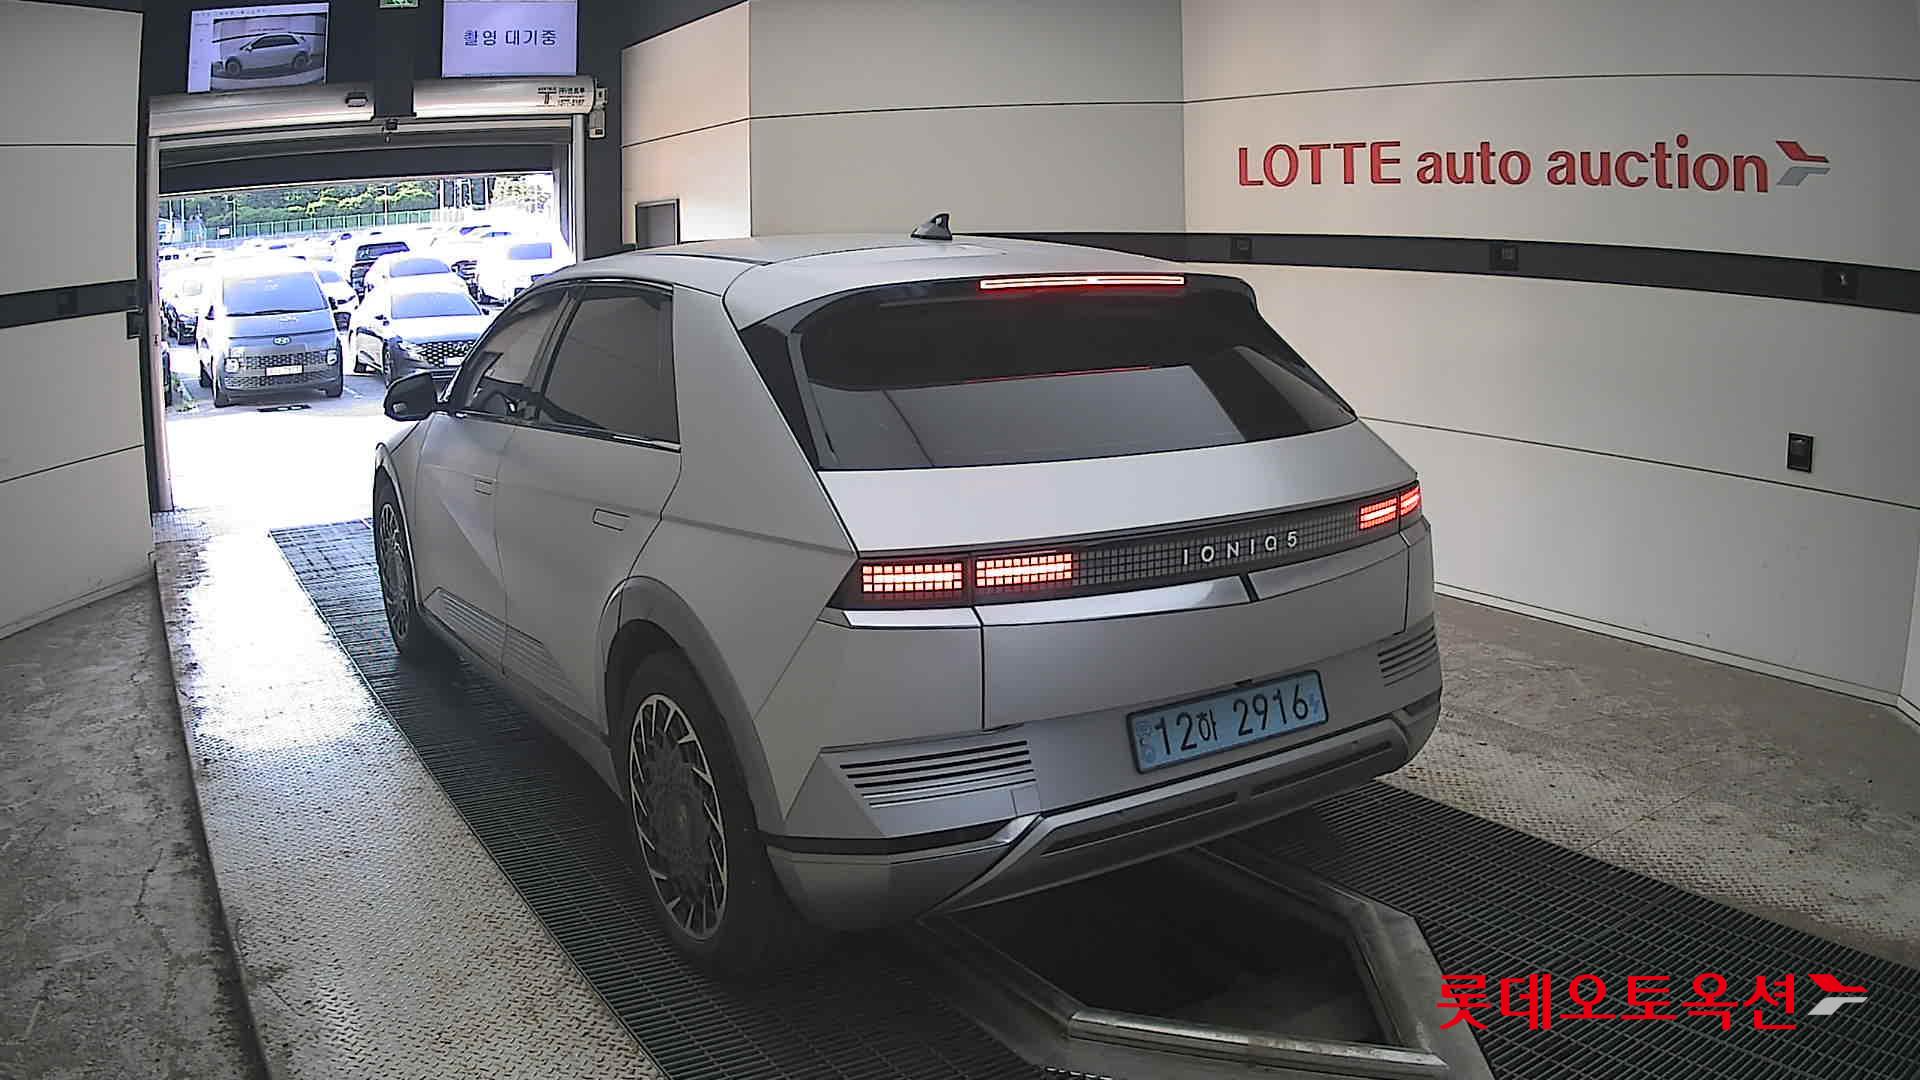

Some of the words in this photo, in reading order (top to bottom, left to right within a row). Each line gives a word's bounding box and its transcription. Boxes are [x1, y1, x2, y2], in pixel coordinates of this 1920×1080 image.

[505, 30, 557, 46] 대기중
[1238, 142, 1400, 186] LOTTE
[1416, 141, 1531, 186] auto
[1546, 134, 1769, 193] auction
[1233, 684, 1309, 736] 2916
